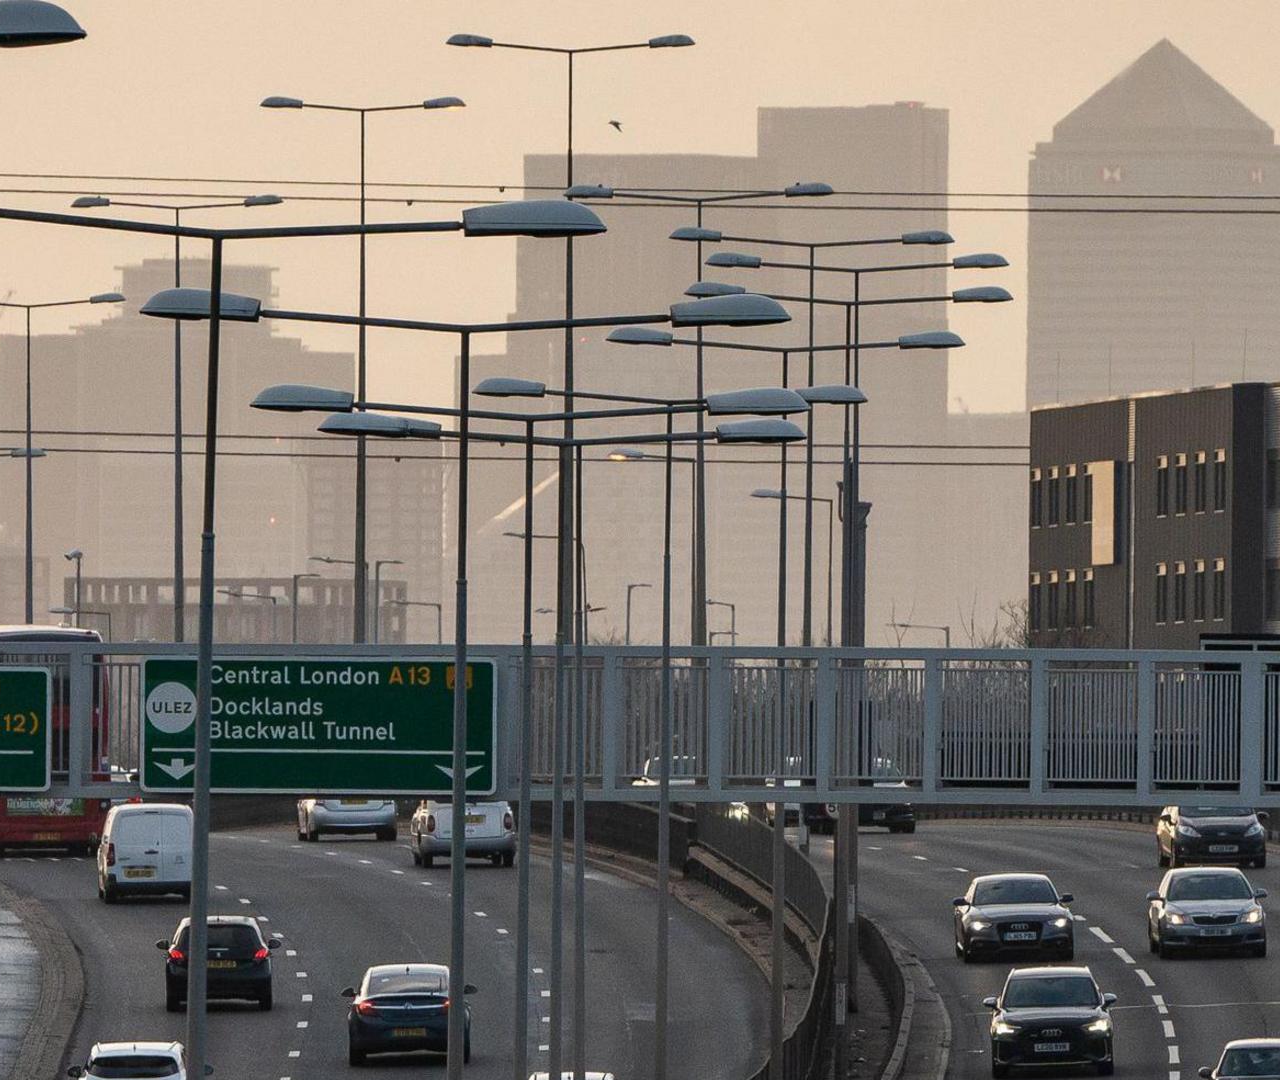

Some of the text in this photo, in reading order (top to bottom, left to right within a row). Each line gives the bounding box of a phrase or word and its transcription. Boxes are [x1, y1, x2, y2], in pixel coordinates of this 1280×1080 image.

[209, 665, 431, 685] Central London A13
[152, 701, 193, 714] ULEZ
[209, 697, 324, 716] Docklands
[209, 721, 396, 741] Blackwall Tunnel
